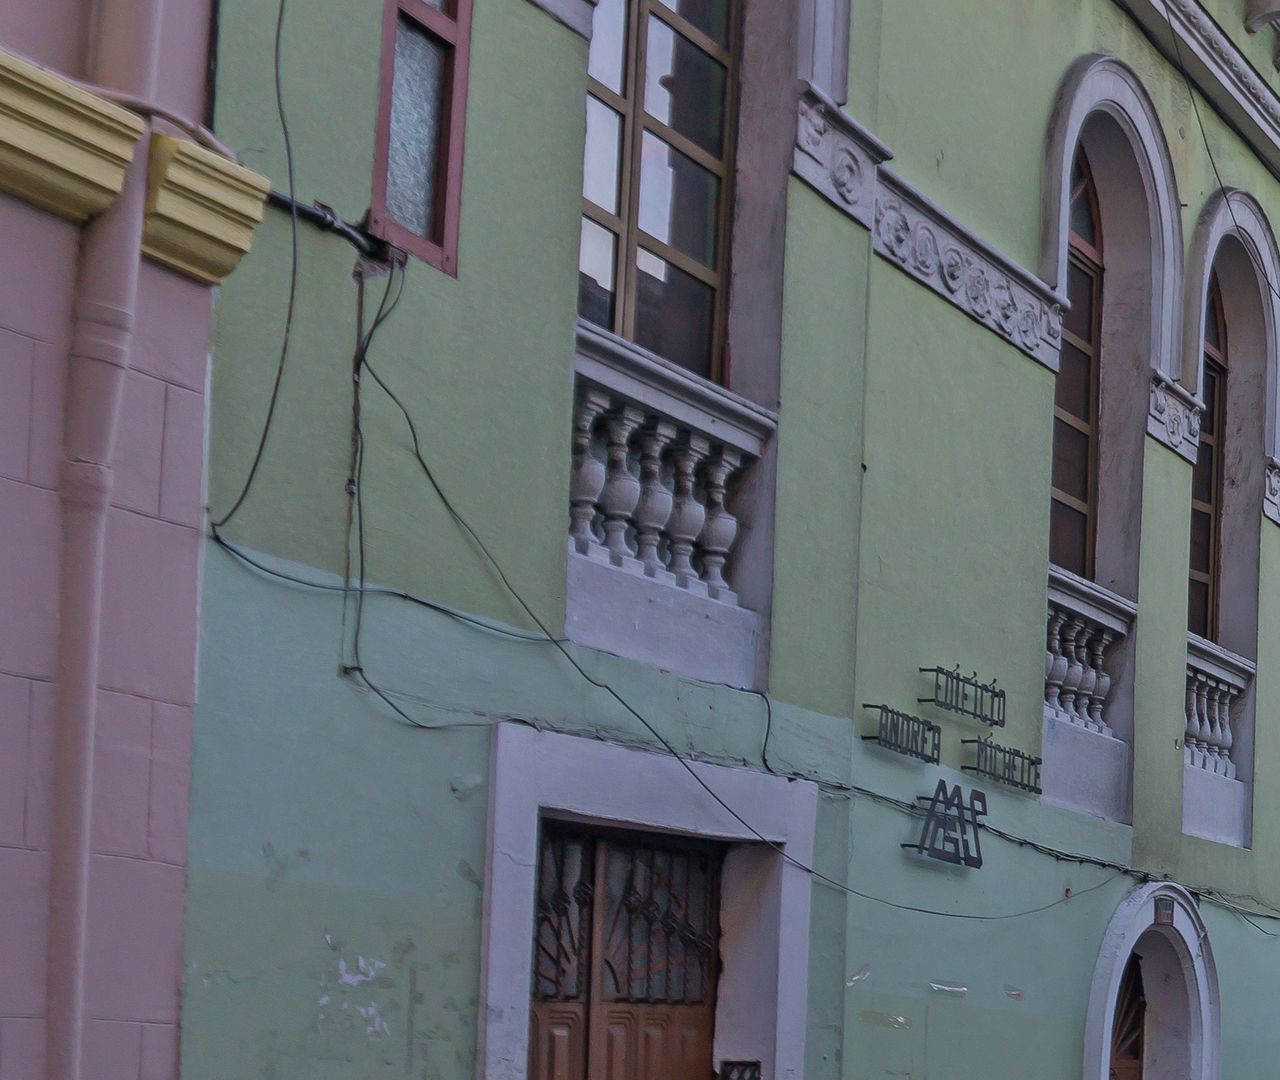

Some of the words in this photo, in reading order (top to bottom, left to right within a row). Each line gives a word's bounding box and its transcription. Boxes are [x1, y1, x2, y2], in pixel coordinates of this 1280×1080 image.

[933, 665, 1006, 728] EDIFICIO
[878, 704, 941, 766] ANDREA
[976, 735, 1042, 795] MICHELLE
